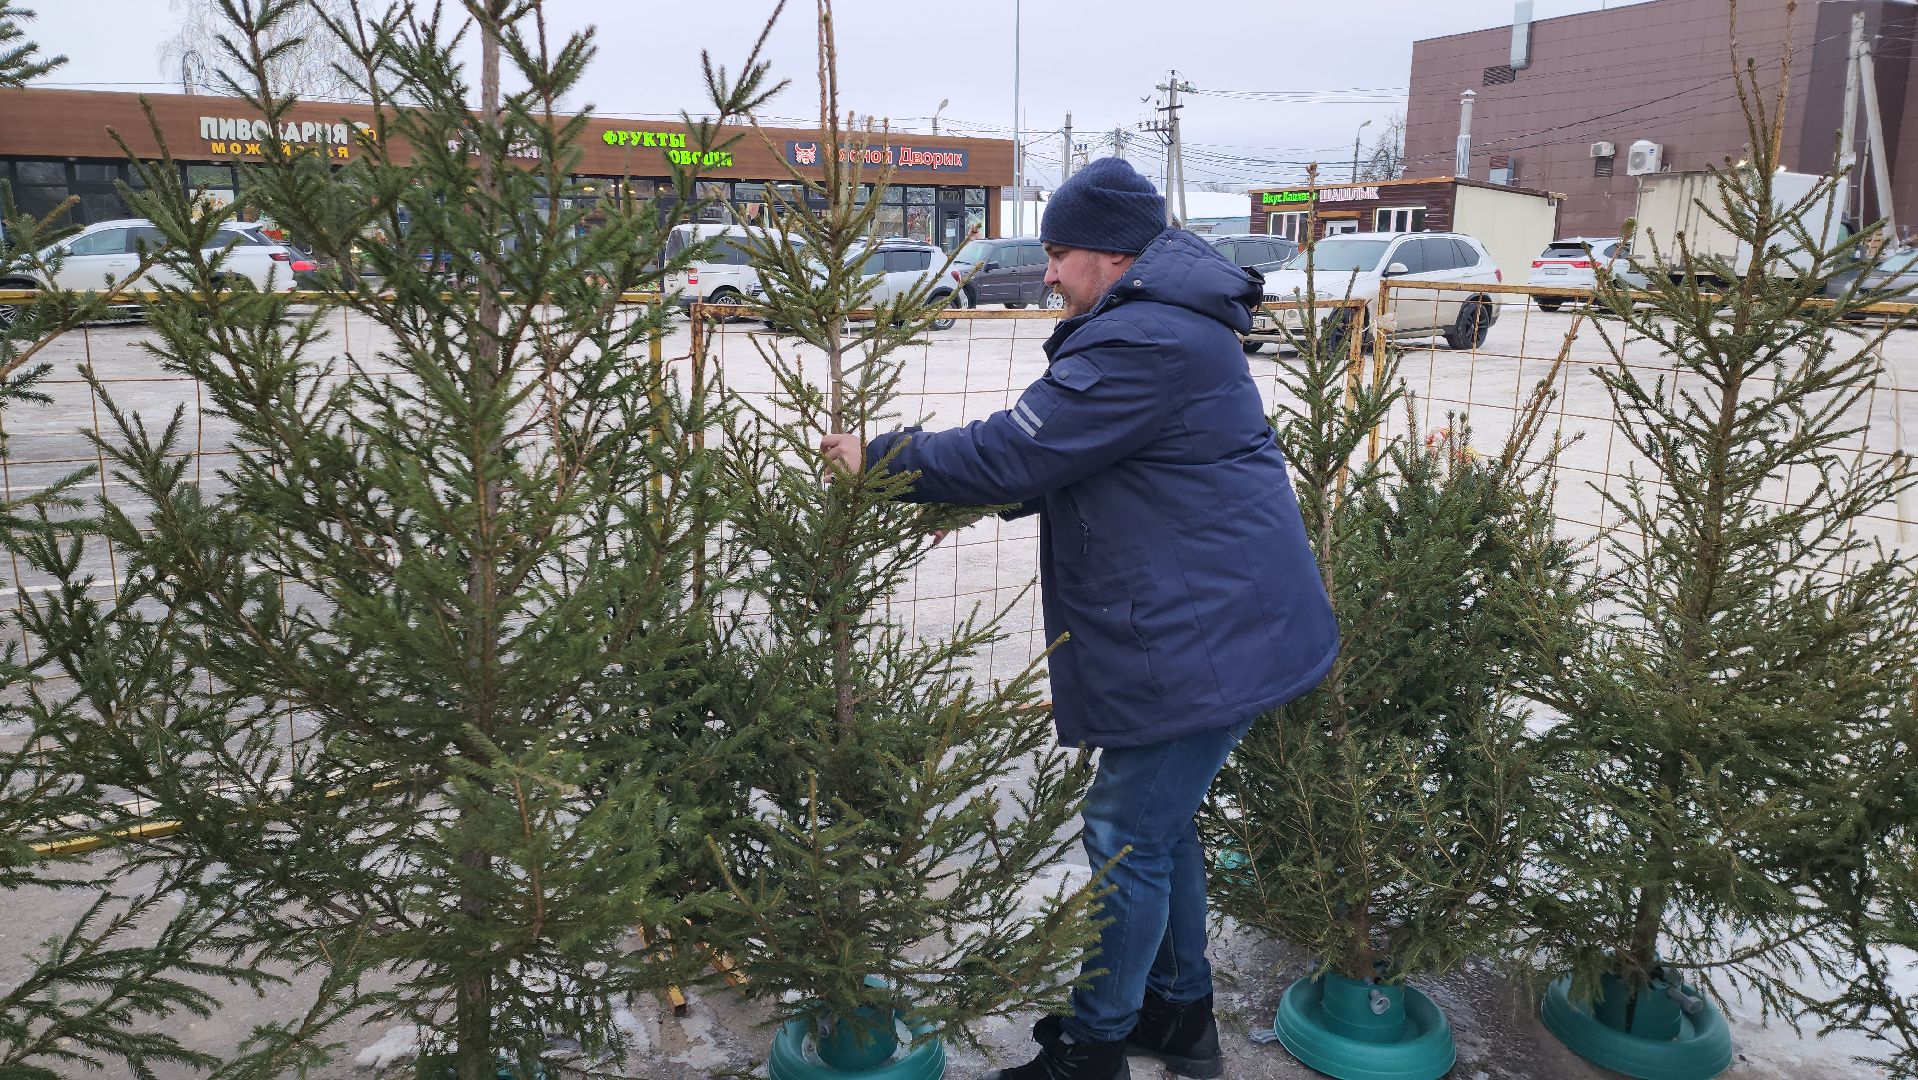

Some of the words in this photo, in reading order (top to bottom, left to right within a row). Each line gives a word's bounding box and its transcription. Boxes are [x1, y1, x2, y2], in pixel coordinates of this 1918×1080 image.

[602, 130, 686, 148] ФРУКТЫ
[823, 144, 893, 164] ясной
[899, 146, 963, 169] Дворик
[1319, 186, 1380, 203] ШАШЛЫК
